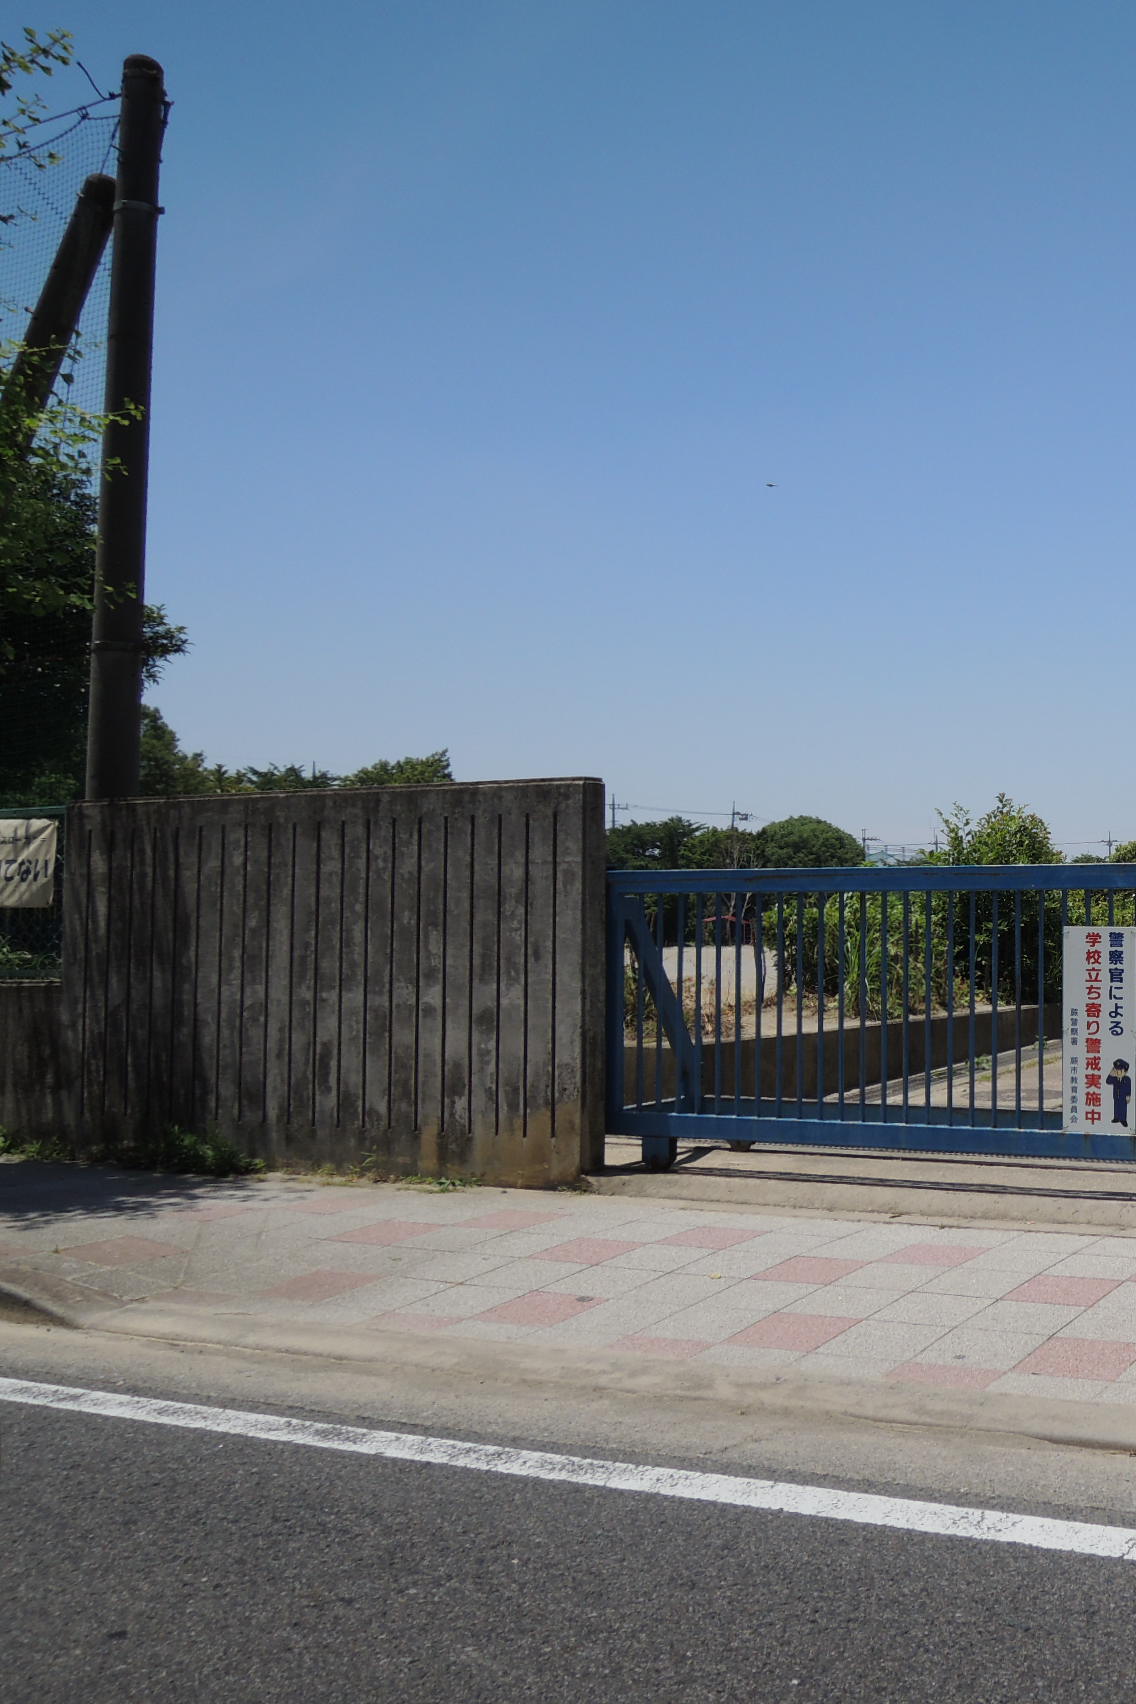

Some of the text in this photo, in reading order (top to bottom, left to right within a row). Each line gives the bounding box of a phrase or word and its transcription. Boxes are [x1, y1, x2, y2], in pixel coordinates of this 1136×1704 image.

[1085, 931, 1102, 1126] 学校立ち寄り警戒実施中
[1108, 931, 1125, 1036] 警察官による
